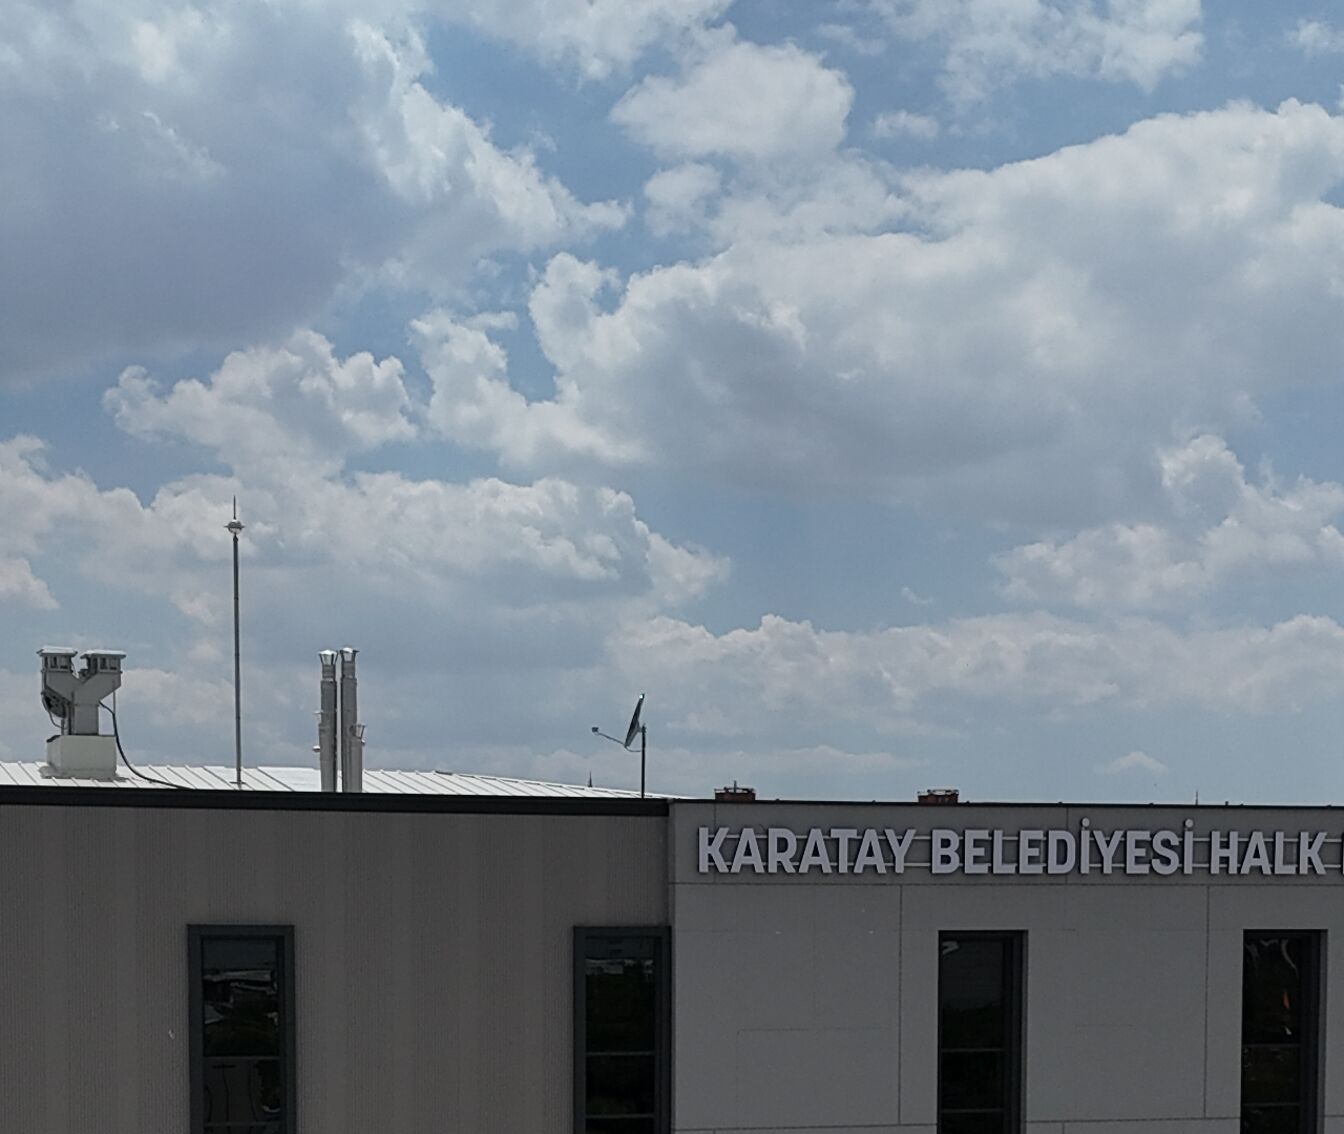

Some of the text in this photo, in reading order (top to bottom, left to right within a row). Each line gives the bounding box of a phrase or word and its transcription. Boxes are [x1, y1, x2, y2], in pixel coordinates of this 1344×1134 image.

[697, 826, 917, 874] KARATAY
[930, 817, 1194, 875] BELEDİYESİ
[1209, 830, 1328, 876] HALK
